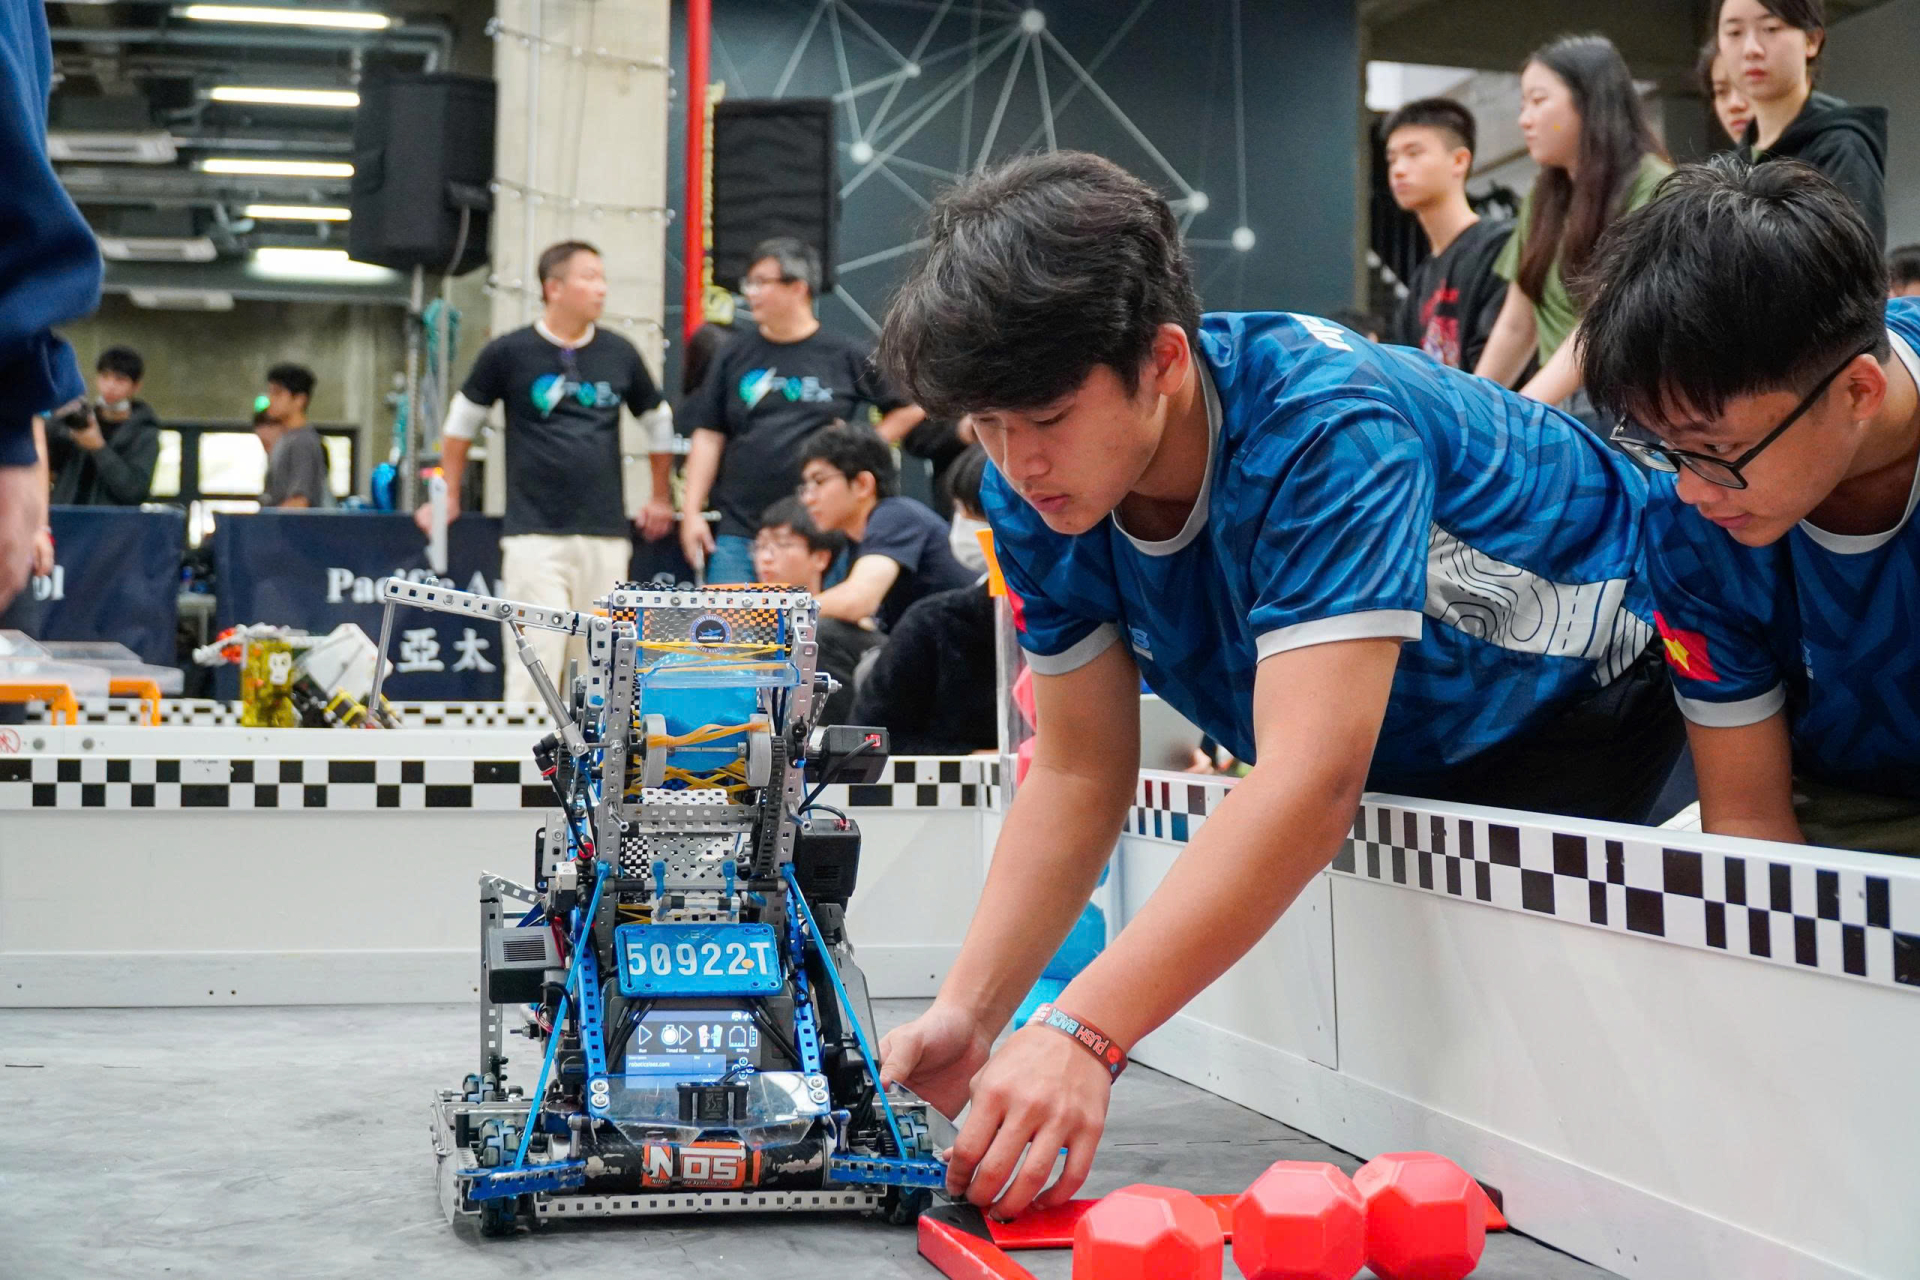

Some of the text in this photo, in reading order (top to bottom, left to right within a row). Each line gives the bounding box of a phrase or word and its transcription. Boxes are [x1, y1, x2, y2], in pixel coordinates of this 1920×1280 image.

[396, 627, 497, 673] 亞太
[626, 942, 770, 976] 50922T
[1046, 1008, 1079, 1035] BACK
[1075, 1026, 1109, 1055] PUSH
[650, 1145, 746, 1180] NOS
